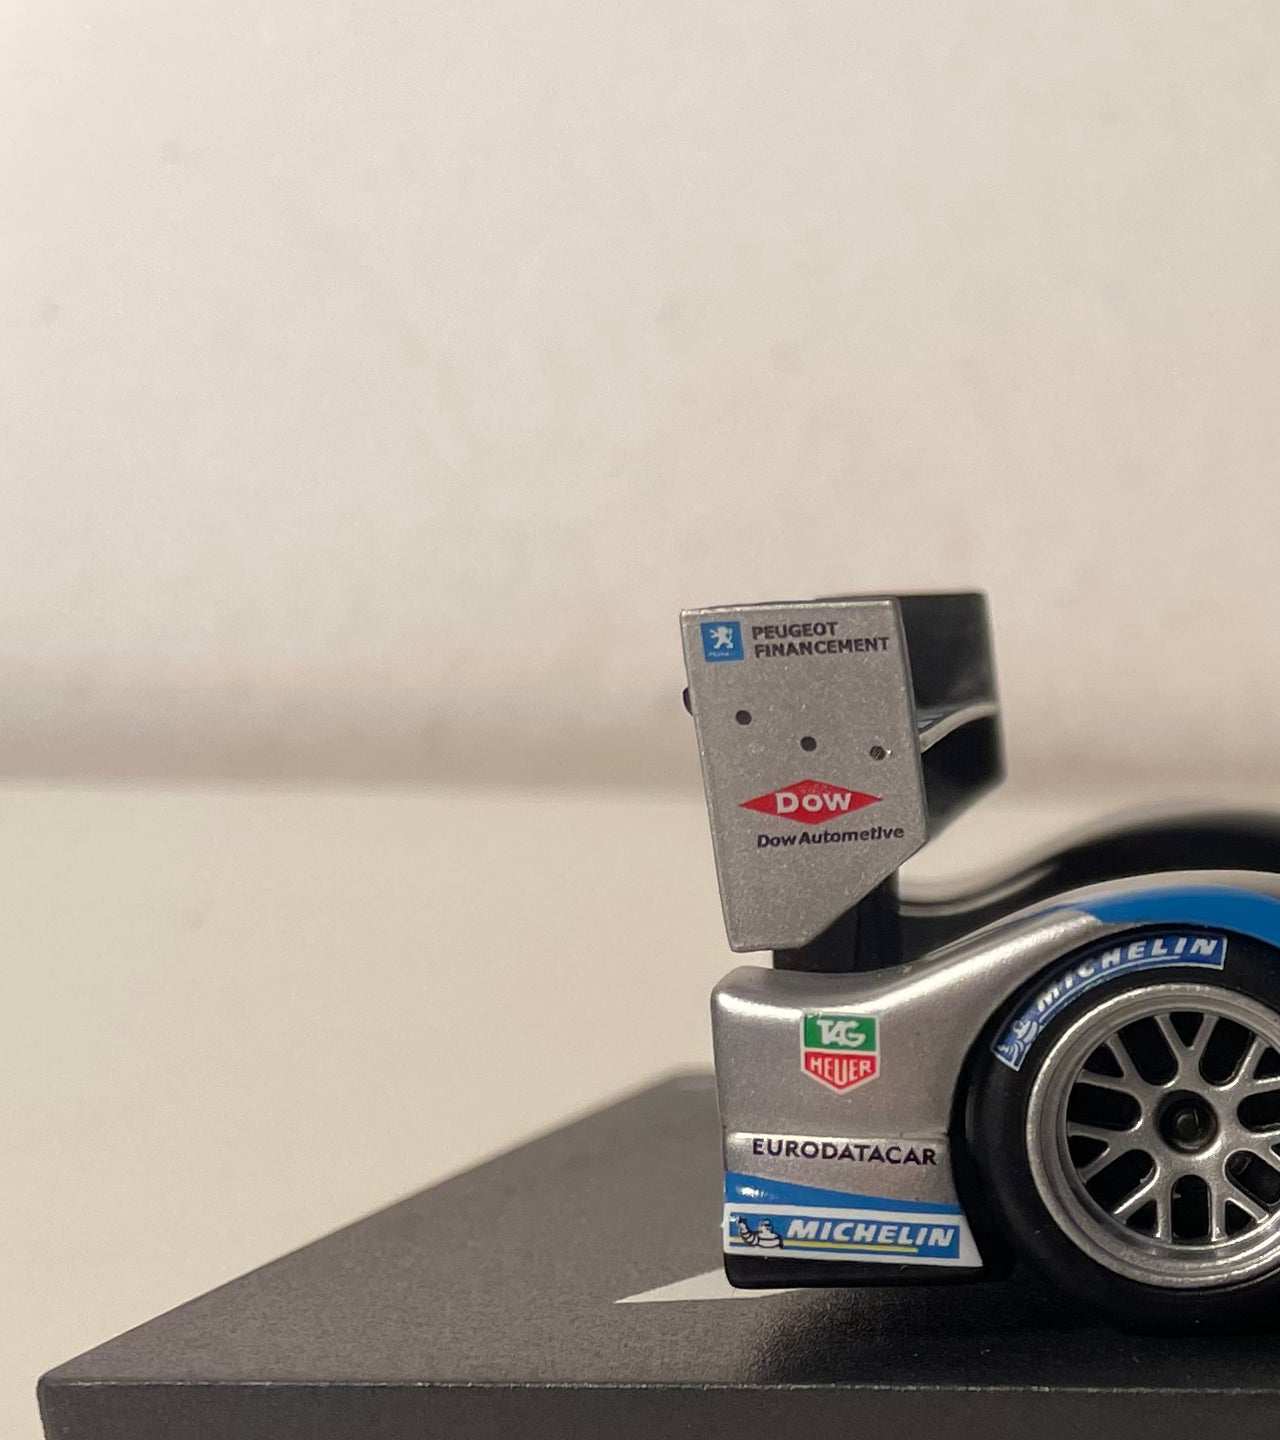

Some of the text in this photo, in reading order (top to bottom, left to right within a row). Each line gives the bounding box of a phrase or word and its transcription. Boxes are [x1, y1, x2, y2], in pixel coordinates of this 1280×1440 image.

[752, 621, 838, 640] PEUGEOT
[754, 637, 890, 658] FINANCEMENT
[1036, 937, 1215, 1011] MICHELIN
[817, 1020, 866, 1047] TAG
[810, 1057, 872, 1086] HEUER
[752, 1138, 937, 1165] EURODATACAR
[786, 1218, 955, 1247] MICHELIN
